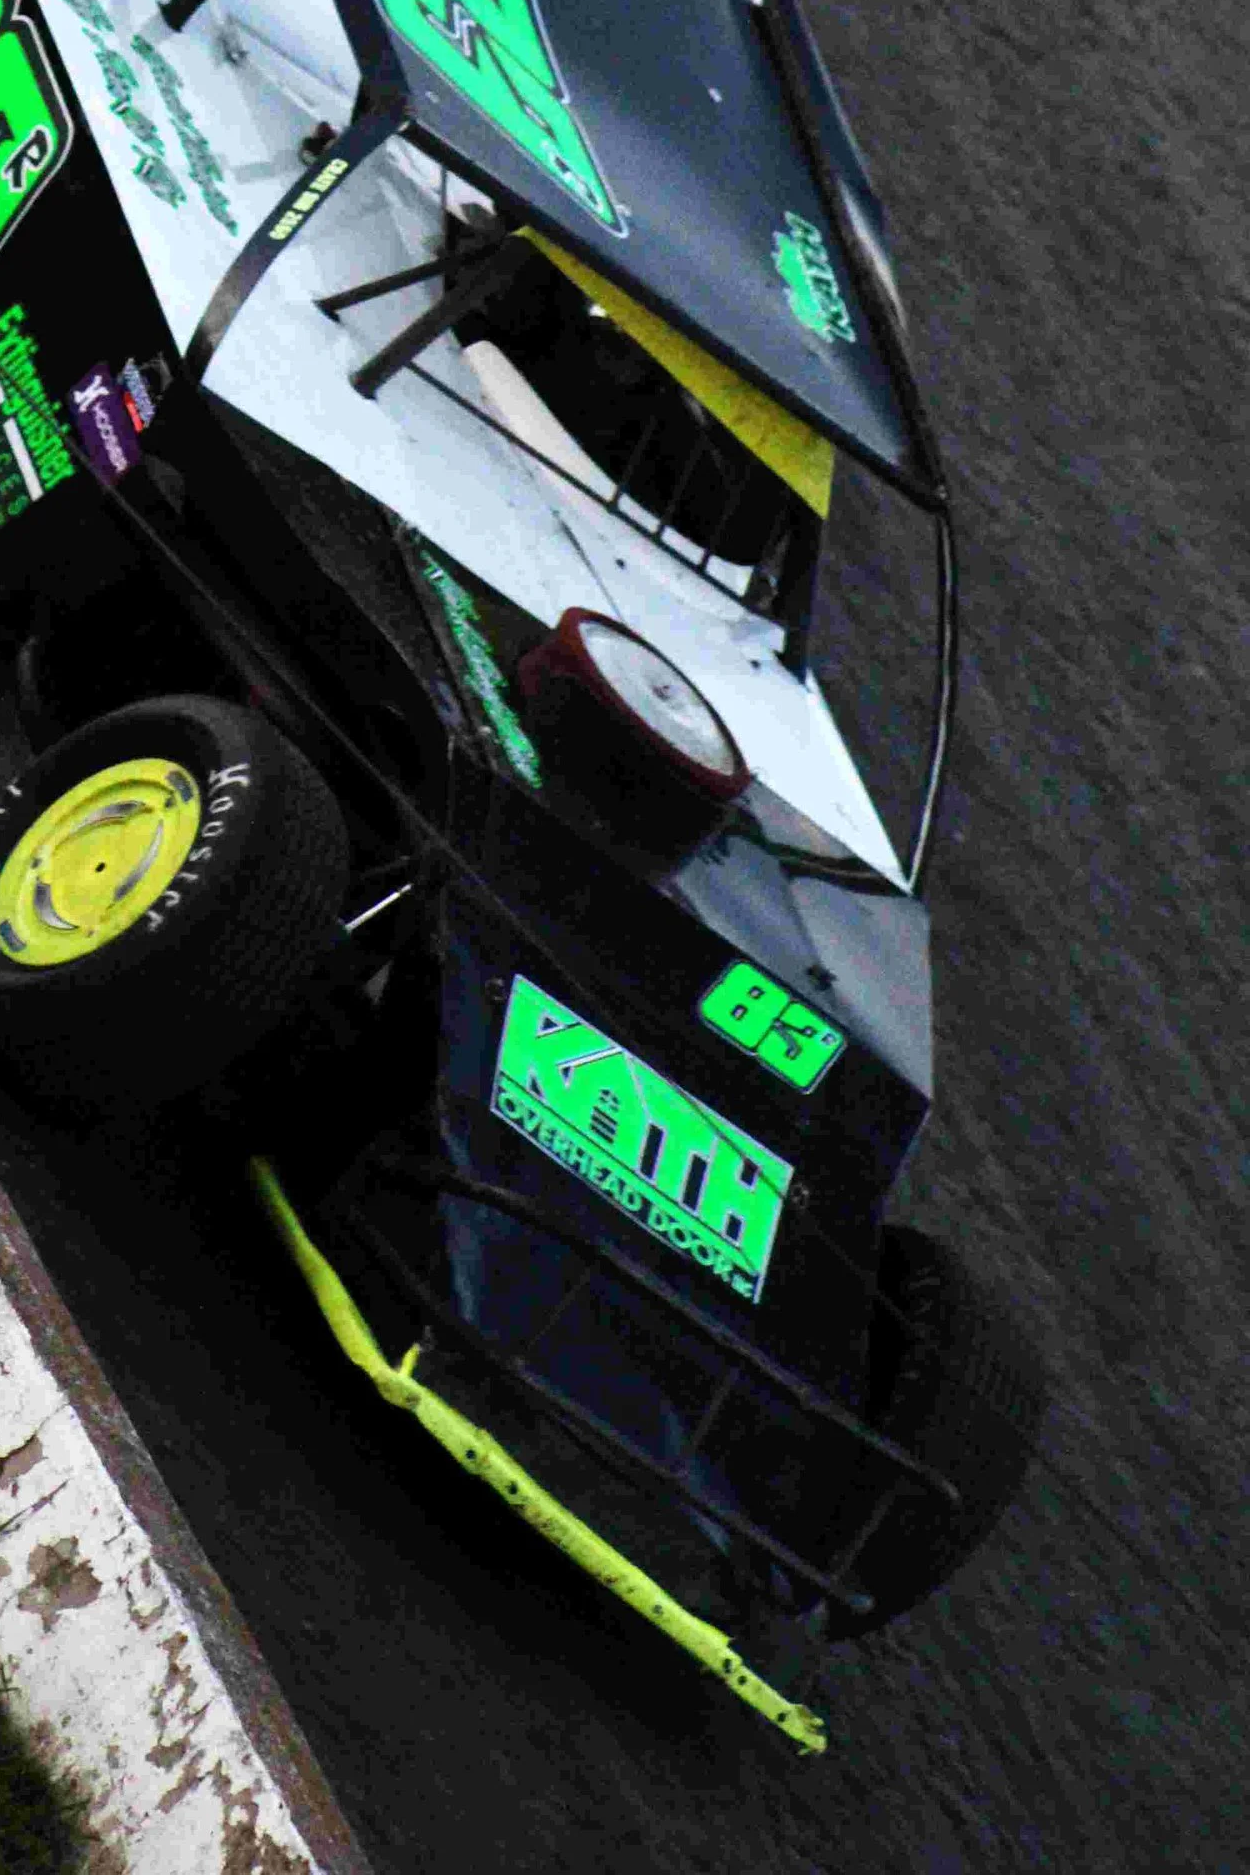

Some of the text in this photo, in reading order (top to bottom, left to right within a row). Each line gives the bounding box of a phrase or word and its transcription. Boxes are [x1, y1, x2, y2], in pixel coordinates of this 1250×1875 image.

[1, 124, 57, 192] R
[698, 960, 844, 1089] 83
[497, 1091, 643, 1211] OVERHEAD
